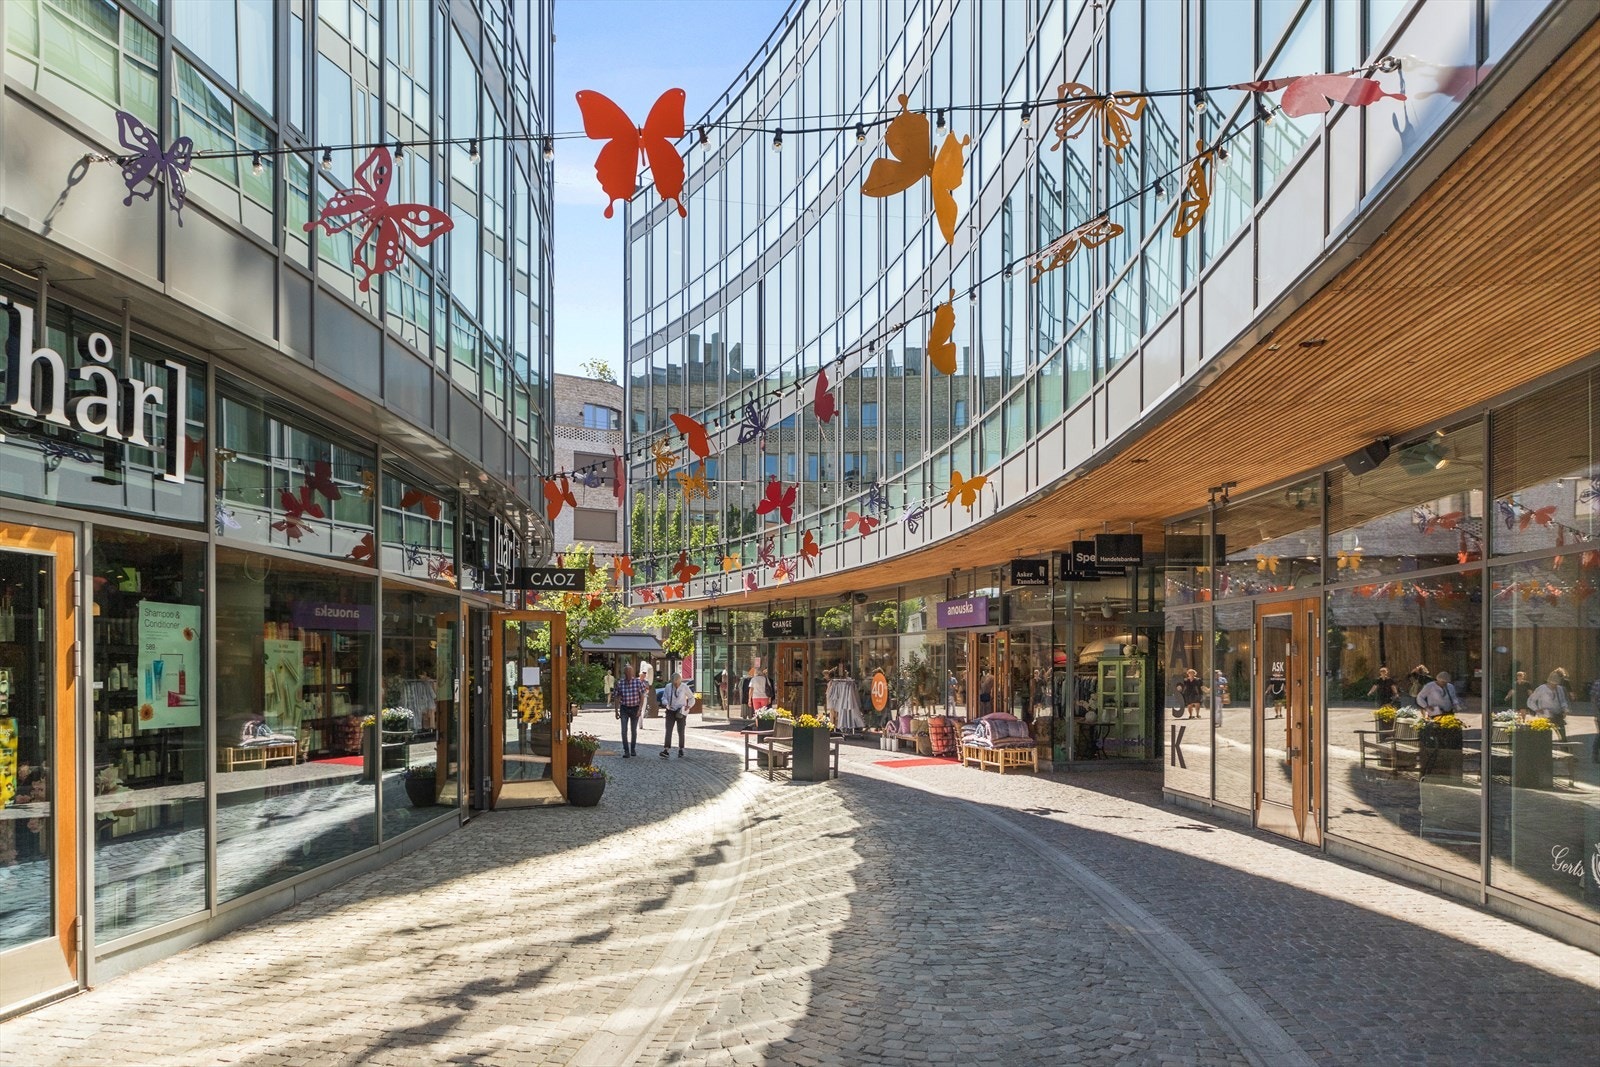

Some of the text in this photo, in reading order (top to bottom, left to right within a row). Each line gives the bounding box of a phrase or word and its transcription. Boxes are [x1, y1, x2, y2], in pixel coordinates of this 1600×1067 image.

[0, 294, 186, 484] hår]
[530, 572, 576, 586] CAOZ
[144, 607, 180, 620] Shampoo &
[947, 600, 974, 616] anouska
[144, 618, 180, 629] Conditioner
[771, 620, 792, 629] CHANGE
[1271, 661, 1285, 672] ASK
[1551, 844, 1585, 877] Gerts
